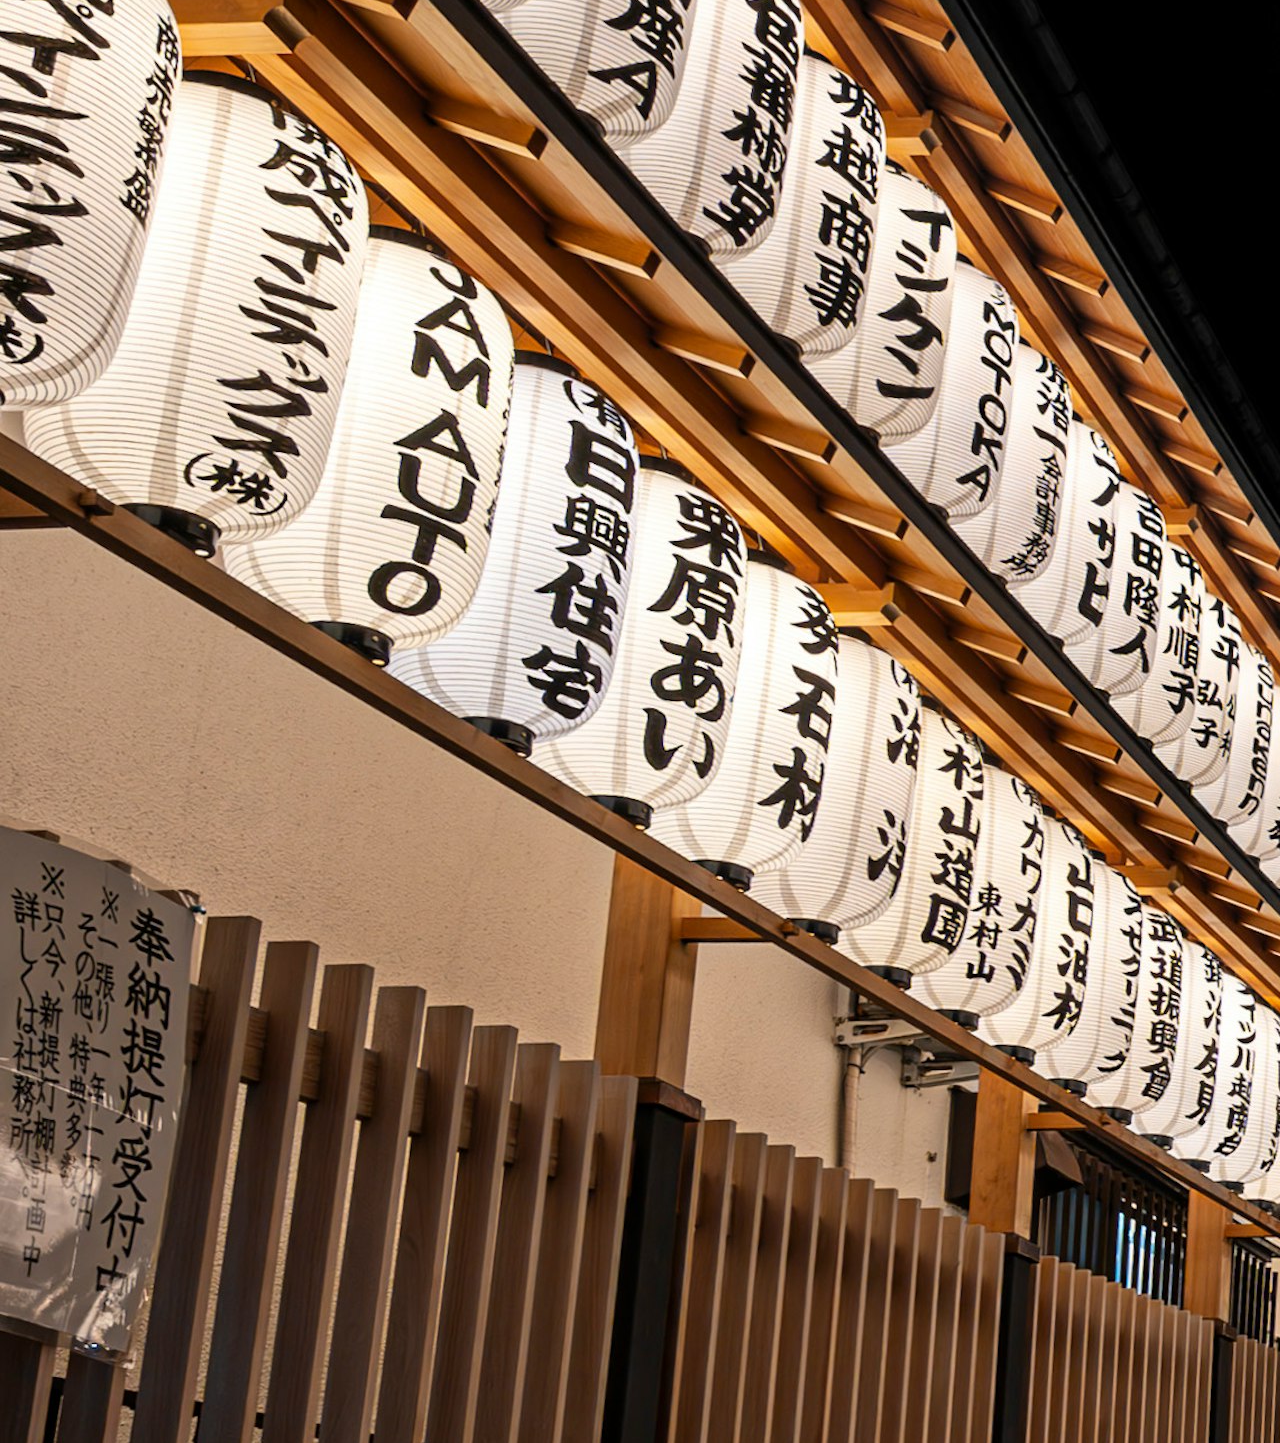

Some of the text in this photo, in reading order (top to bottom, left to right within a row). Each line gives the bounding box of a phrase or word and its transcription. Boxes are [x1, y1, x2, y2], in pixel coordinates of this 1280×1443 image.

[644, 491, 746, 778] 栗原あい
[966, 880, 1005, 983] 東村山
